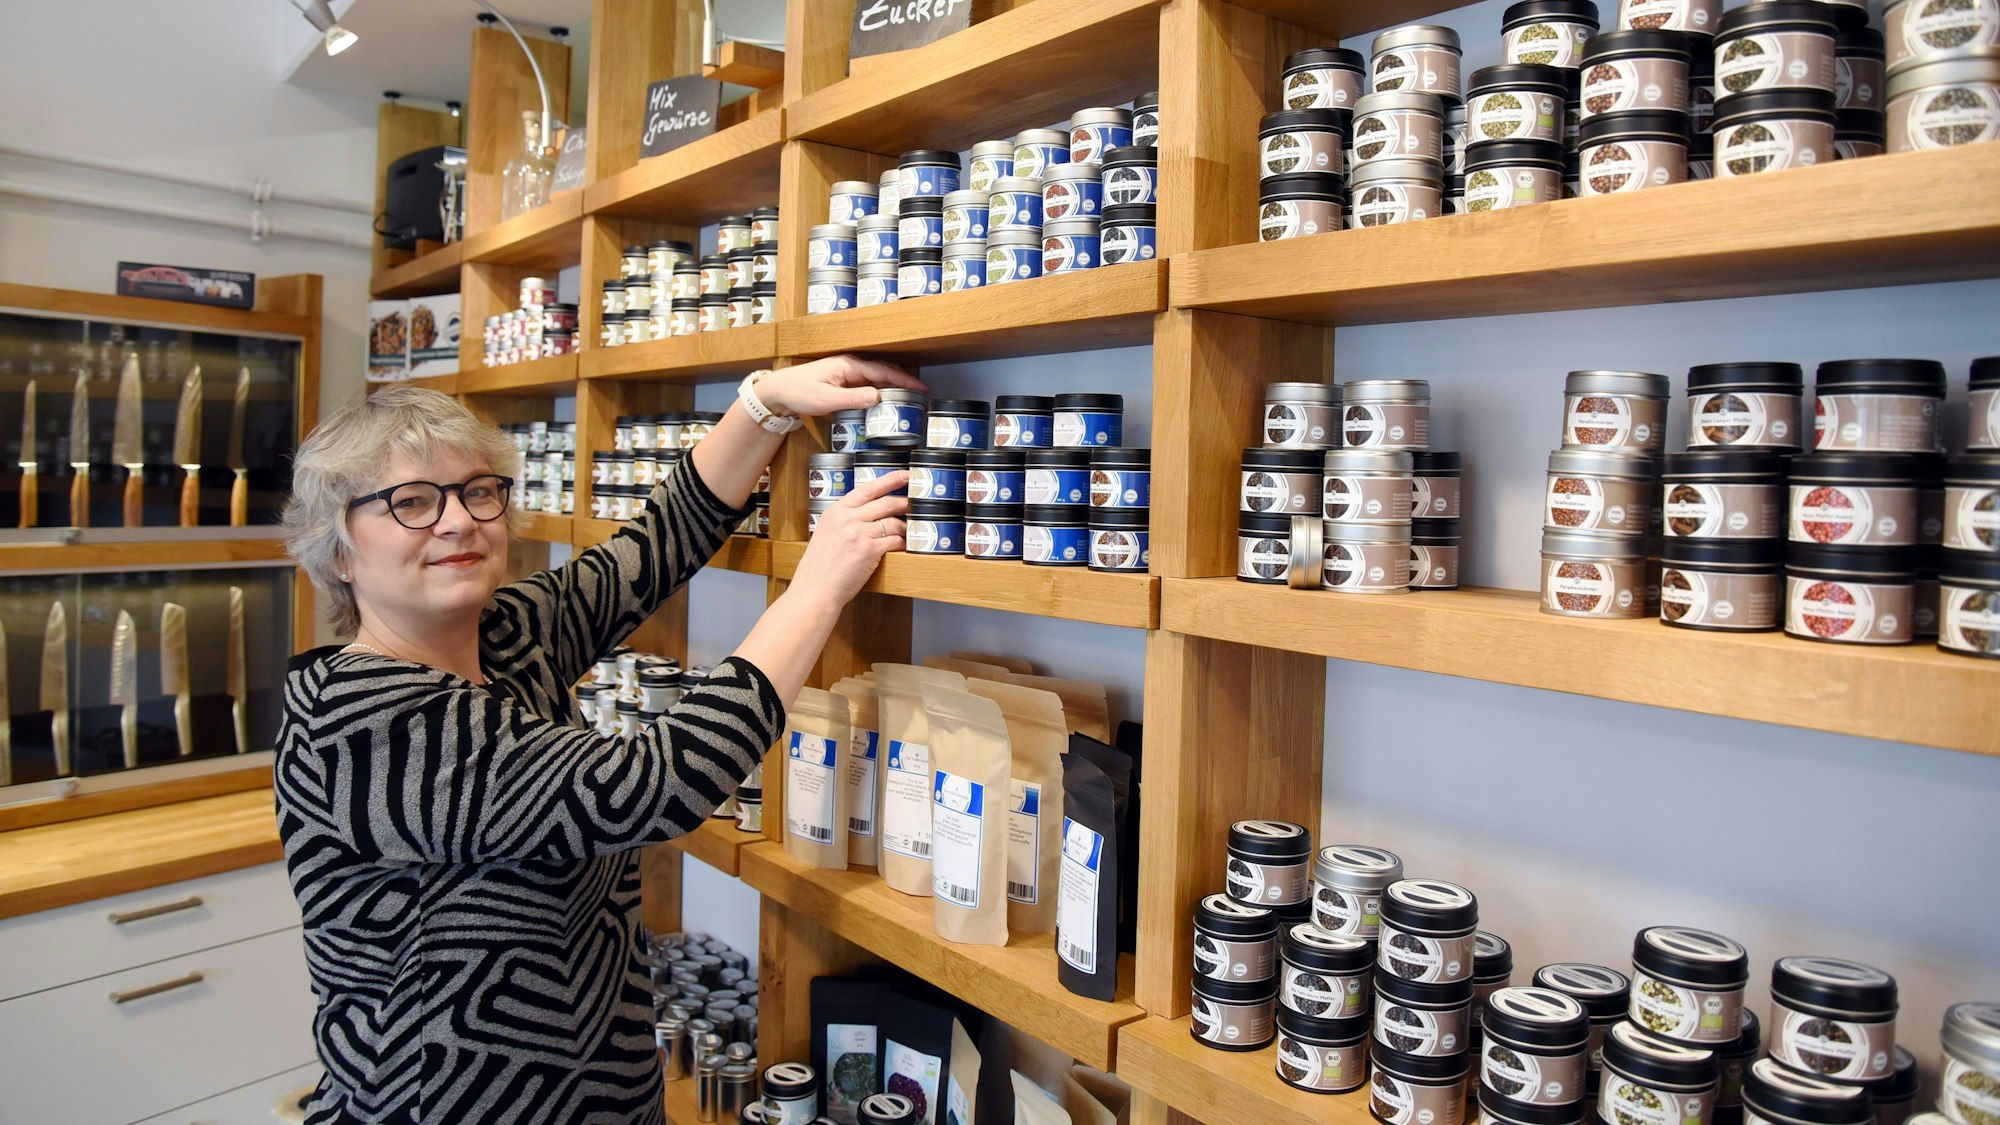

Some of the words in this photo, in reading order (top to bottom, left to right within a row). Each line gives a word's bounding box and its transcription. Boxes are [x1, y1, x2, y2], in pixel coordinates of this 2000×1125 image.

[649, 84, 678, 111] Mix
[642, 110, 712, 146] Gewürze
[1404, 954, 1420, 963] Pfeffer
[1400, 1028, 1416, 1036] Pfeffer
[1298, 1062, 1312, 1070] Pfeffer
